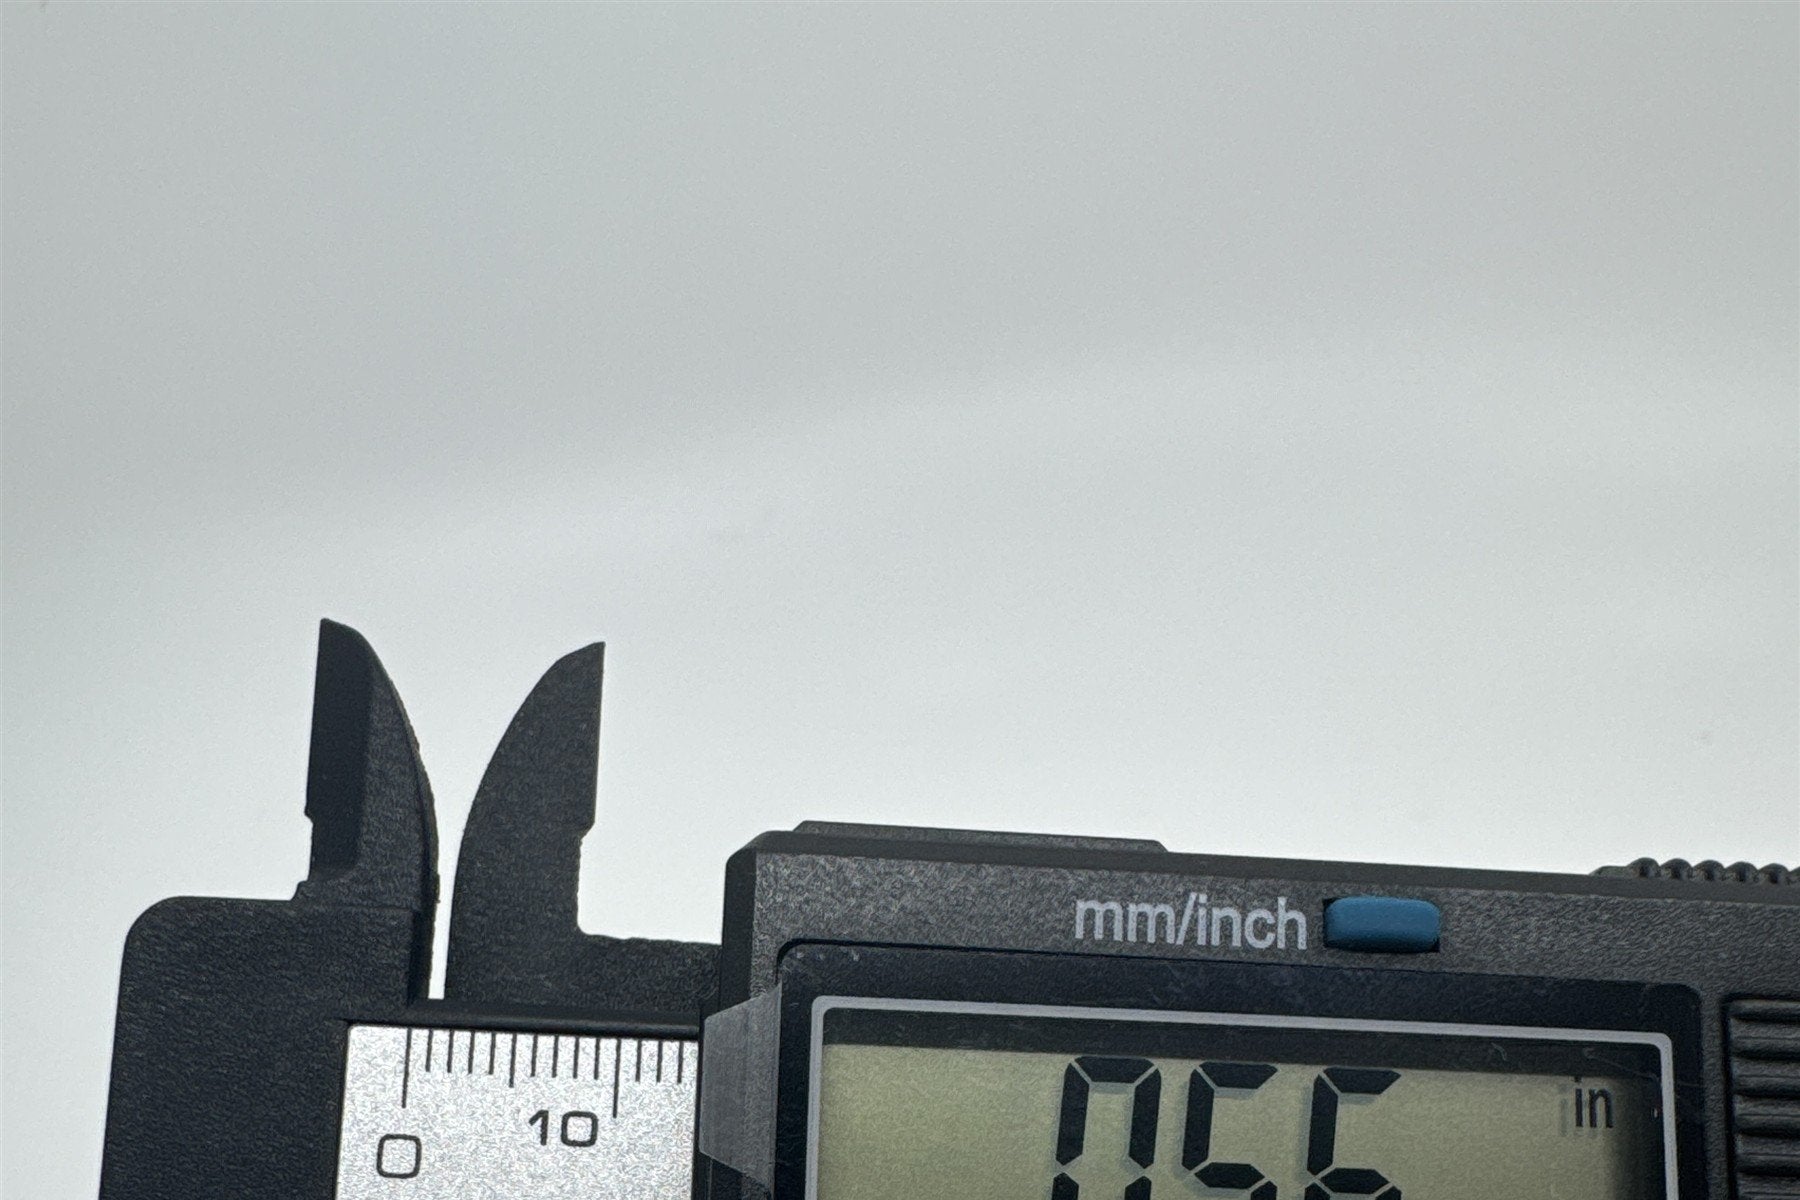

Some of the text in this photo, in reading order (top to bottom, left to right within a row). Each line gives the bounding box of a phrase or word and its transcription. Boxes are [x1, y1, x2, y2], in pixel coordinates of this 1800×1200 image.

[1074, 893, 1308, 951] mm/inch
[1573, 1076, 1614, 1129] in
[529, 1109, 598, 1147] 10
[376, 1134, 422, 1179] 0
